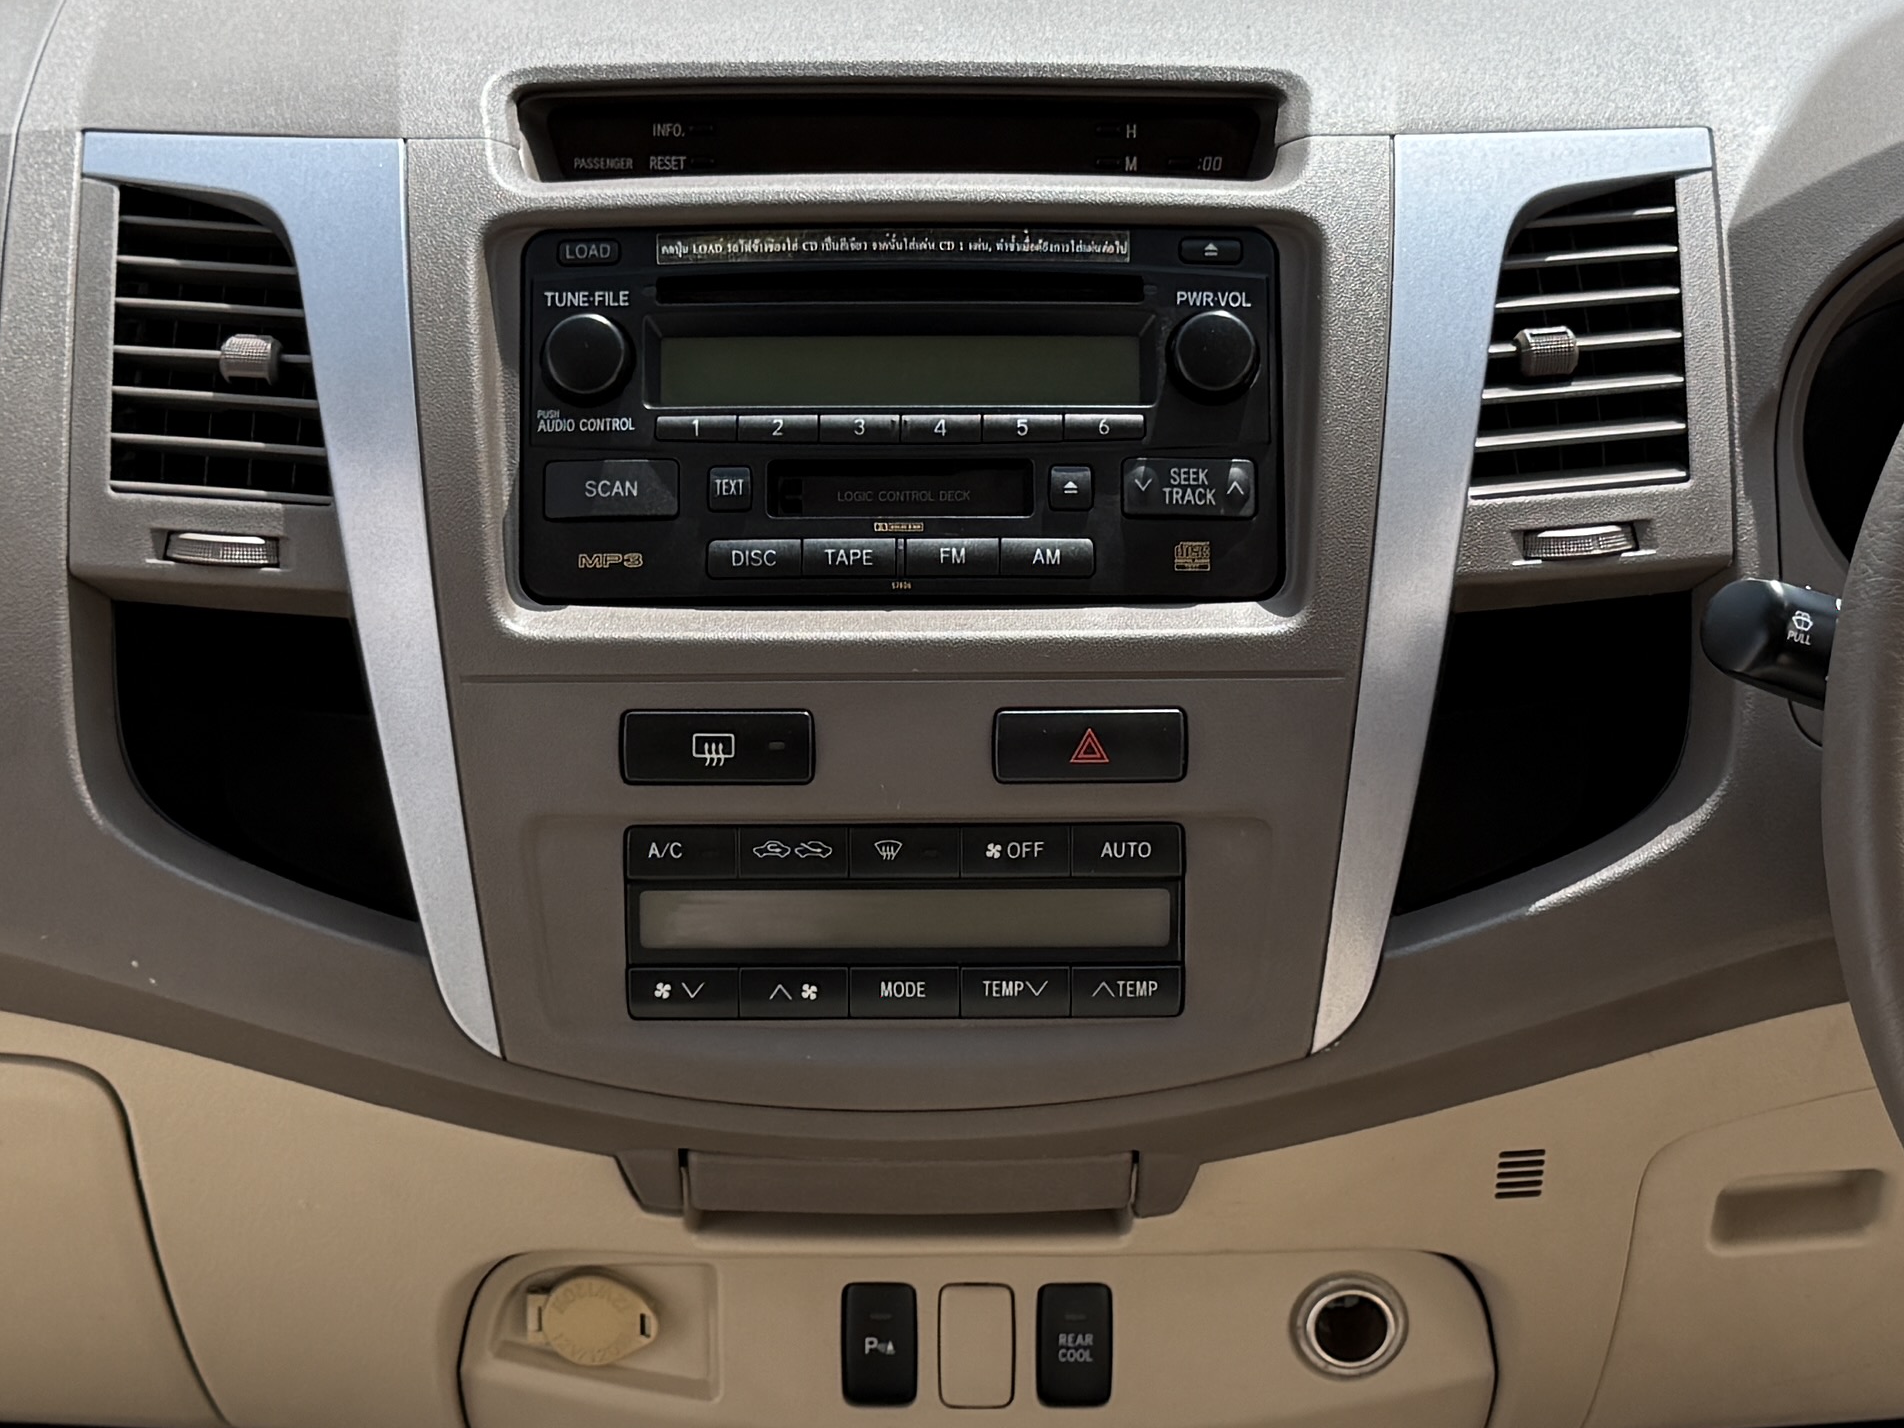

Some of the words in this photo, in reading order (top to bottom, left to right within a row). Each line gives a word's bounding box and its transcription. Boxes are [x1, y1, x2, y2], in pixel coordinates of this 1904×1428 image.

[1126, 123, 1137, 139] H
[573, 157, 634, 170] PASSENGER
[648, 155, 687, 170] RESET
[1125, 156, 1138, 172] M
[566, 244, 610, 259] LOAD
[692, 243, 723, 254] LOAD
[802, 242, 819, 251] CD
[939, 242, 955, 251] CD
[536, 410, 561, 419] PUSH
[538, 418, 575, 432] AUDIO
[580, 418, 635, 431] CONTROL
[693, 420, 698, 435] 1
[773, 420, 783, 435] 2
[855, 420, 864, 434] 3
[935, 420, 945, 435] 4
[1017, 420, 1027, 435] 5
[1100, 420, 1109, 433] 6
[1171, 468, 1208, 484] SEEK
[586, 480, 637, 497] SCAN
[715, 479, 743, 495] TEXT
[838, 491, 872, 501] LOGIC
[878, 490, 935, 502] CONTROL
[938, 490, 971, 502] DECK
[1163, 488, 1215, 505] TRACK
[579, 553, 643, 568] MP3
[731, 549, 777, 567] DISC
[824, 549, 875, 567] TAPE
[939, 547, 967, 565] FM
[1032, 548, 1062, 566] AM
[1786, 630, 1812, 646] PULL
[649, 842, 682, 858] A/C
[1008, 842, 1044, 858] OFF
[1101, 842, 1151, 858] AUTO
[881, 982, 925, 997] MODE
[983, 981, 1023, 996] TEMP
[1117, 981, 1157, 997] TEMP
[1059, 1334, 1093, 1347] REAR
[1059, 1349, 1092, 1362] COOL
